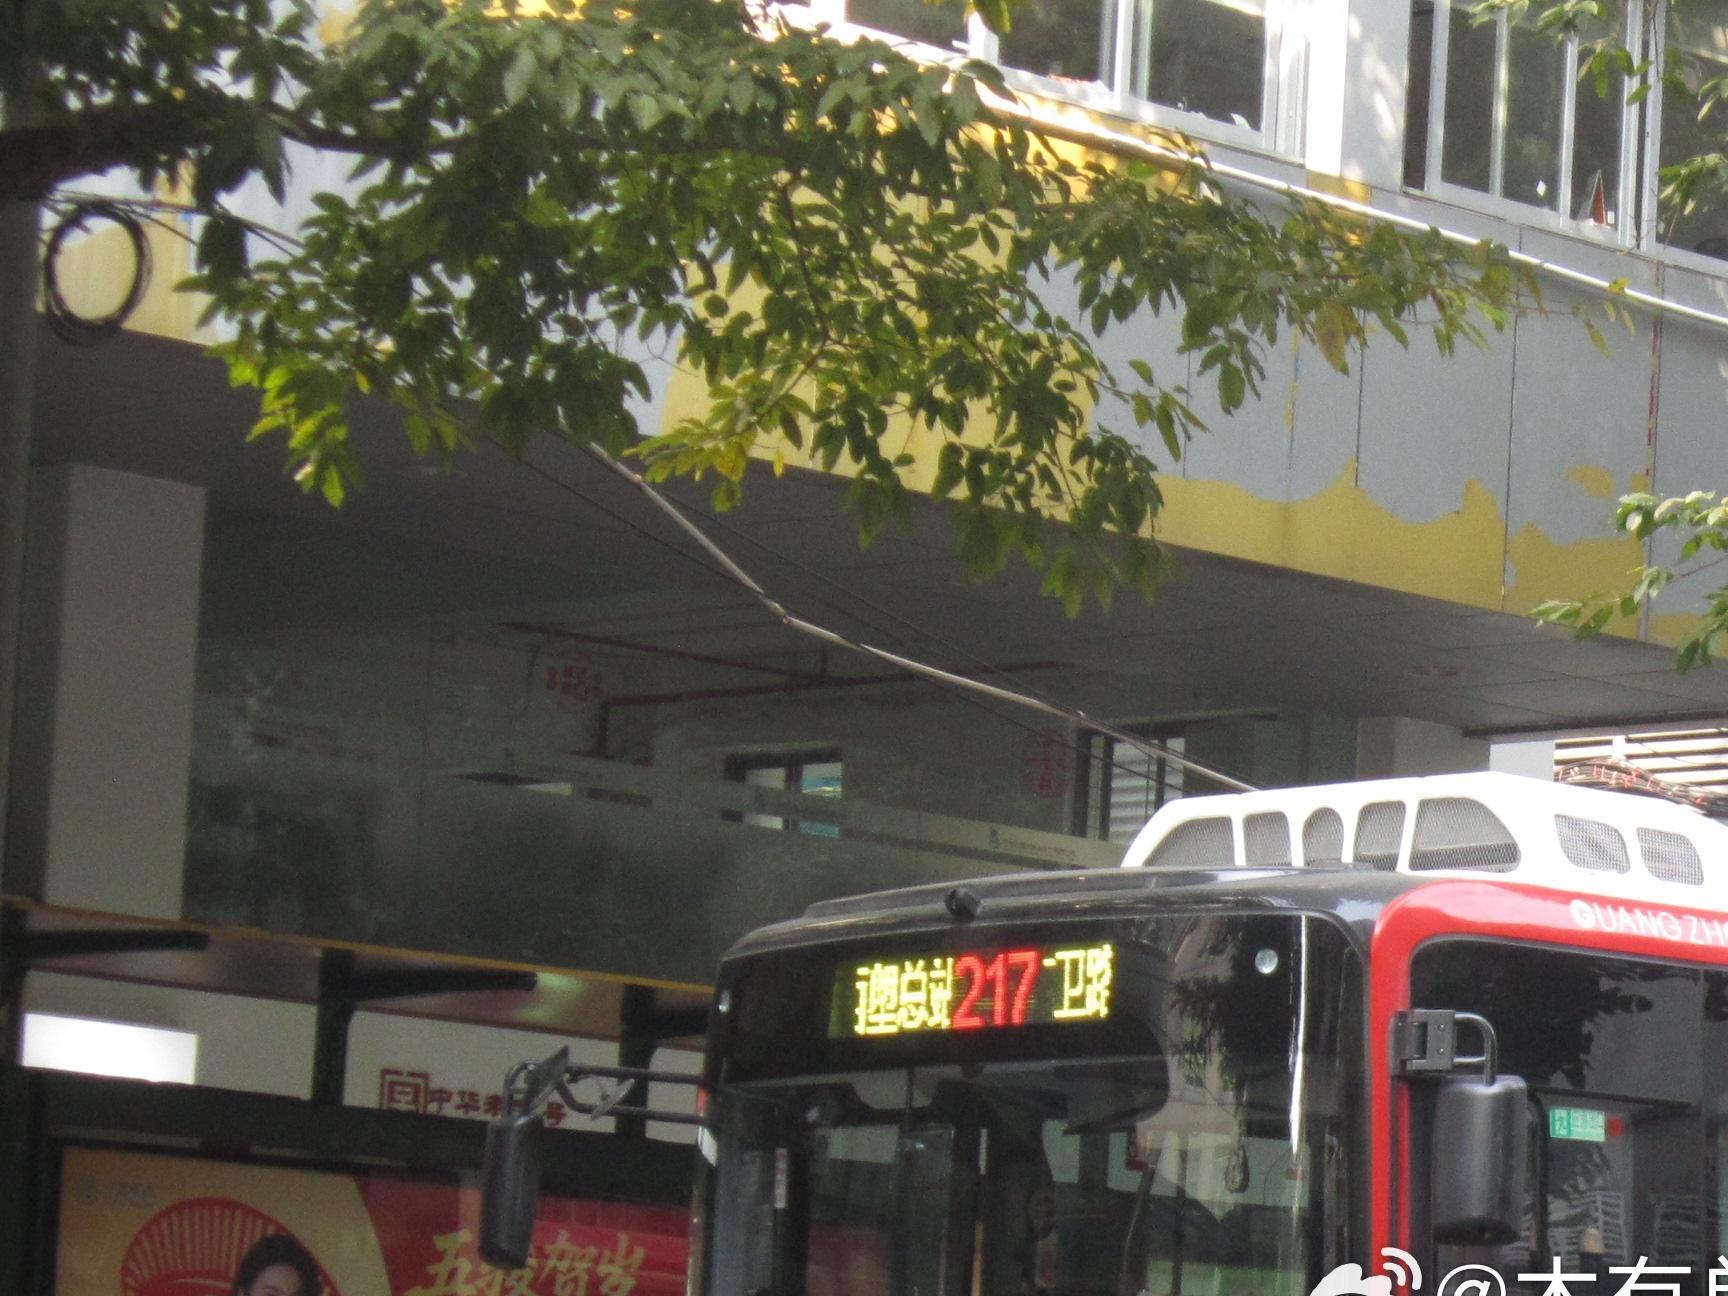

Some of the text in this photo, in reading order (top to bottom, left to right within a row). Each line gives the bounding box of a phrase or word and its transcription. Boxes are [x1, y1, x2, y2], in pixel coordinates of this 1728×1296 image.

[952, 948, 1038, 1028] 217
[1043, 944, 1112, 1018] 卫路
[428, 1087, 567, 1127] 中华老号
